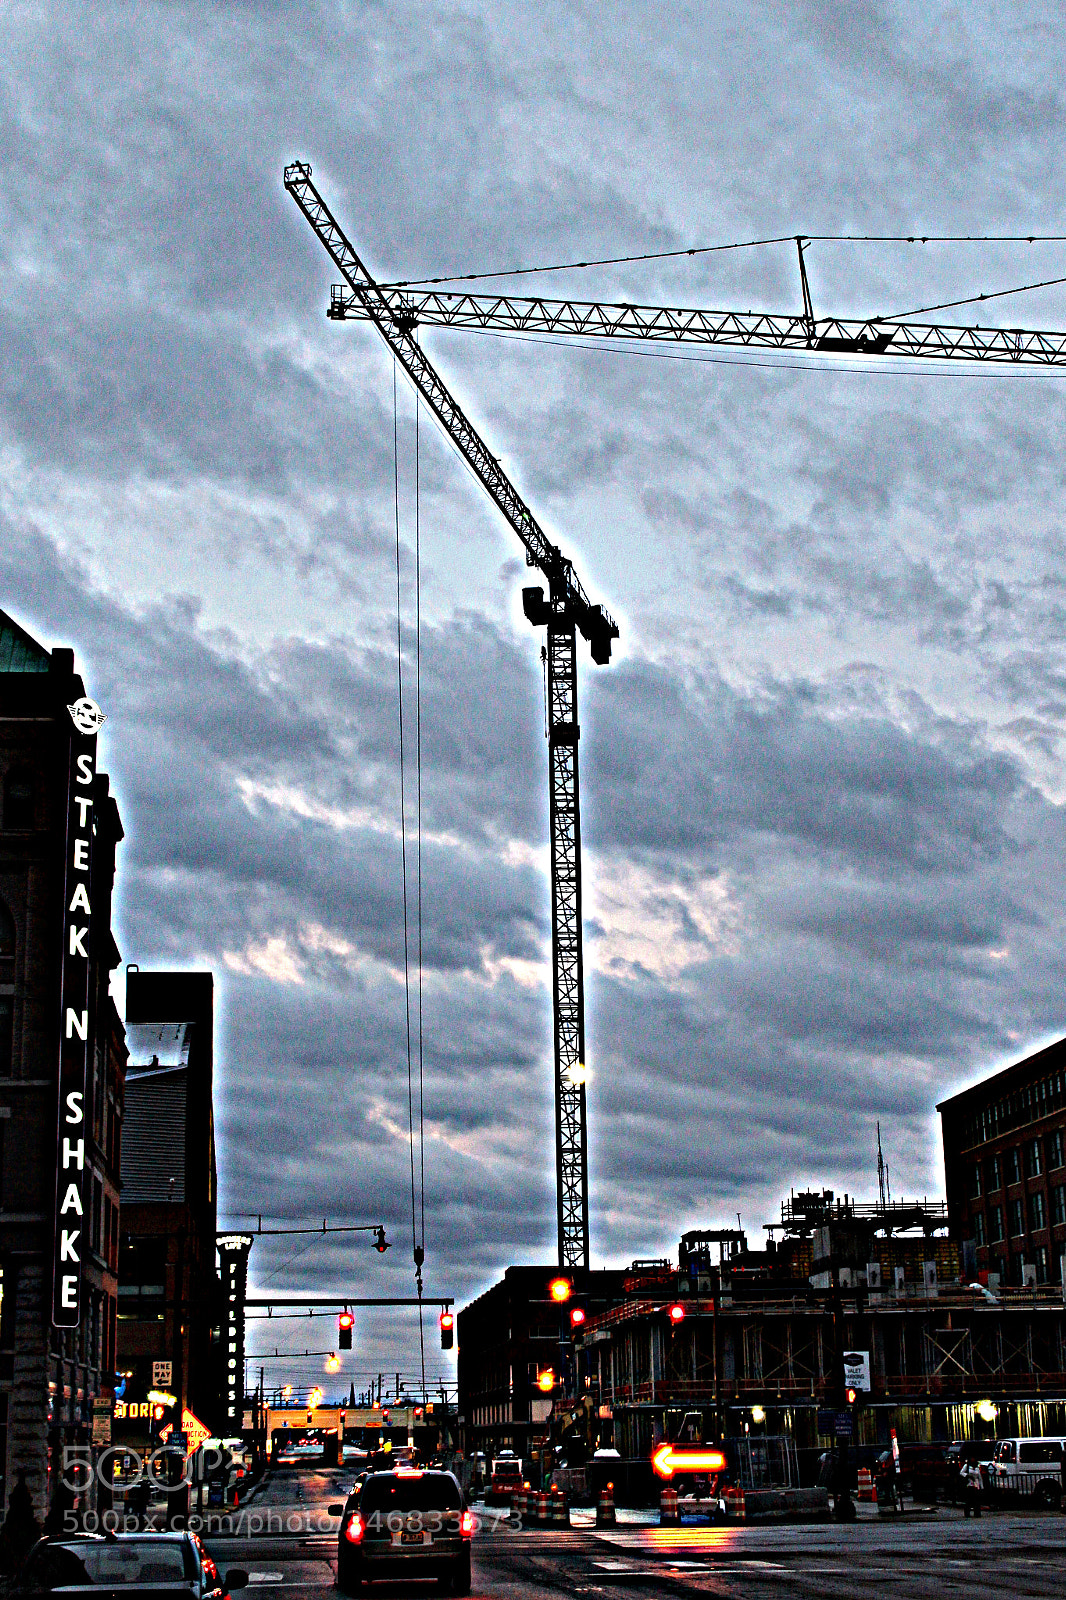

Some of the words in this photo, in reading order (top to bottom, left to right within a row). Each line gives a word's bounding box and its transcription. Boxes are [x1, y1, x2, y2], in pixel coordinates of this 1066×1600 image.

[68, 754, 93, 958] STEAK
[65, 1007, 88, 1041] N
[60, 1091, 85, 1309] SHAKE
[228, 1263, 237, 1417] FIELDHOUSE
